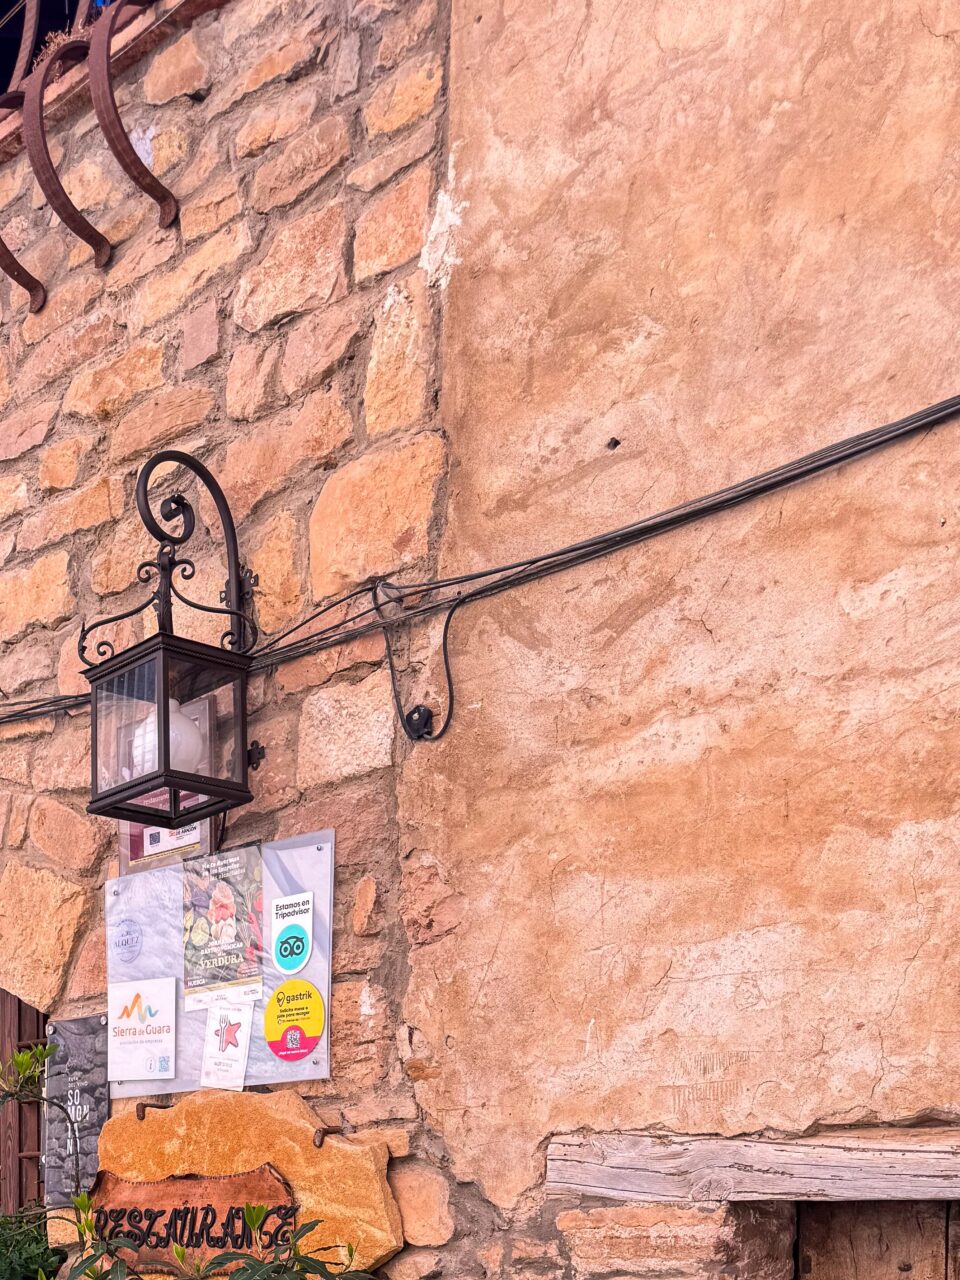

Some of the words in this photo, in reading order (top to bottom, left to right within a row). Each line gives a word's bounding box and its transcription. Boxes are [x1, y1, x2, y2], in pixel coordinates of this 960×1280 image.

[275, 902, 301, 911] Estamos
[275, 908, 310, 920] Tripadvisor
[199, 953, 244, 970] VERDURA
[286, 990, 312, 1004] gastrik
[112, 1026, 137, 1038] Sierra
[138, 1028, 145, 1036] de
[145, 1024, 171, 1035] Guara
[67, 1089, 80, 1105] SO
[67, 1105, 90, 1122] MON
[93, 1203, 300, 1249] RESTAURANTE
